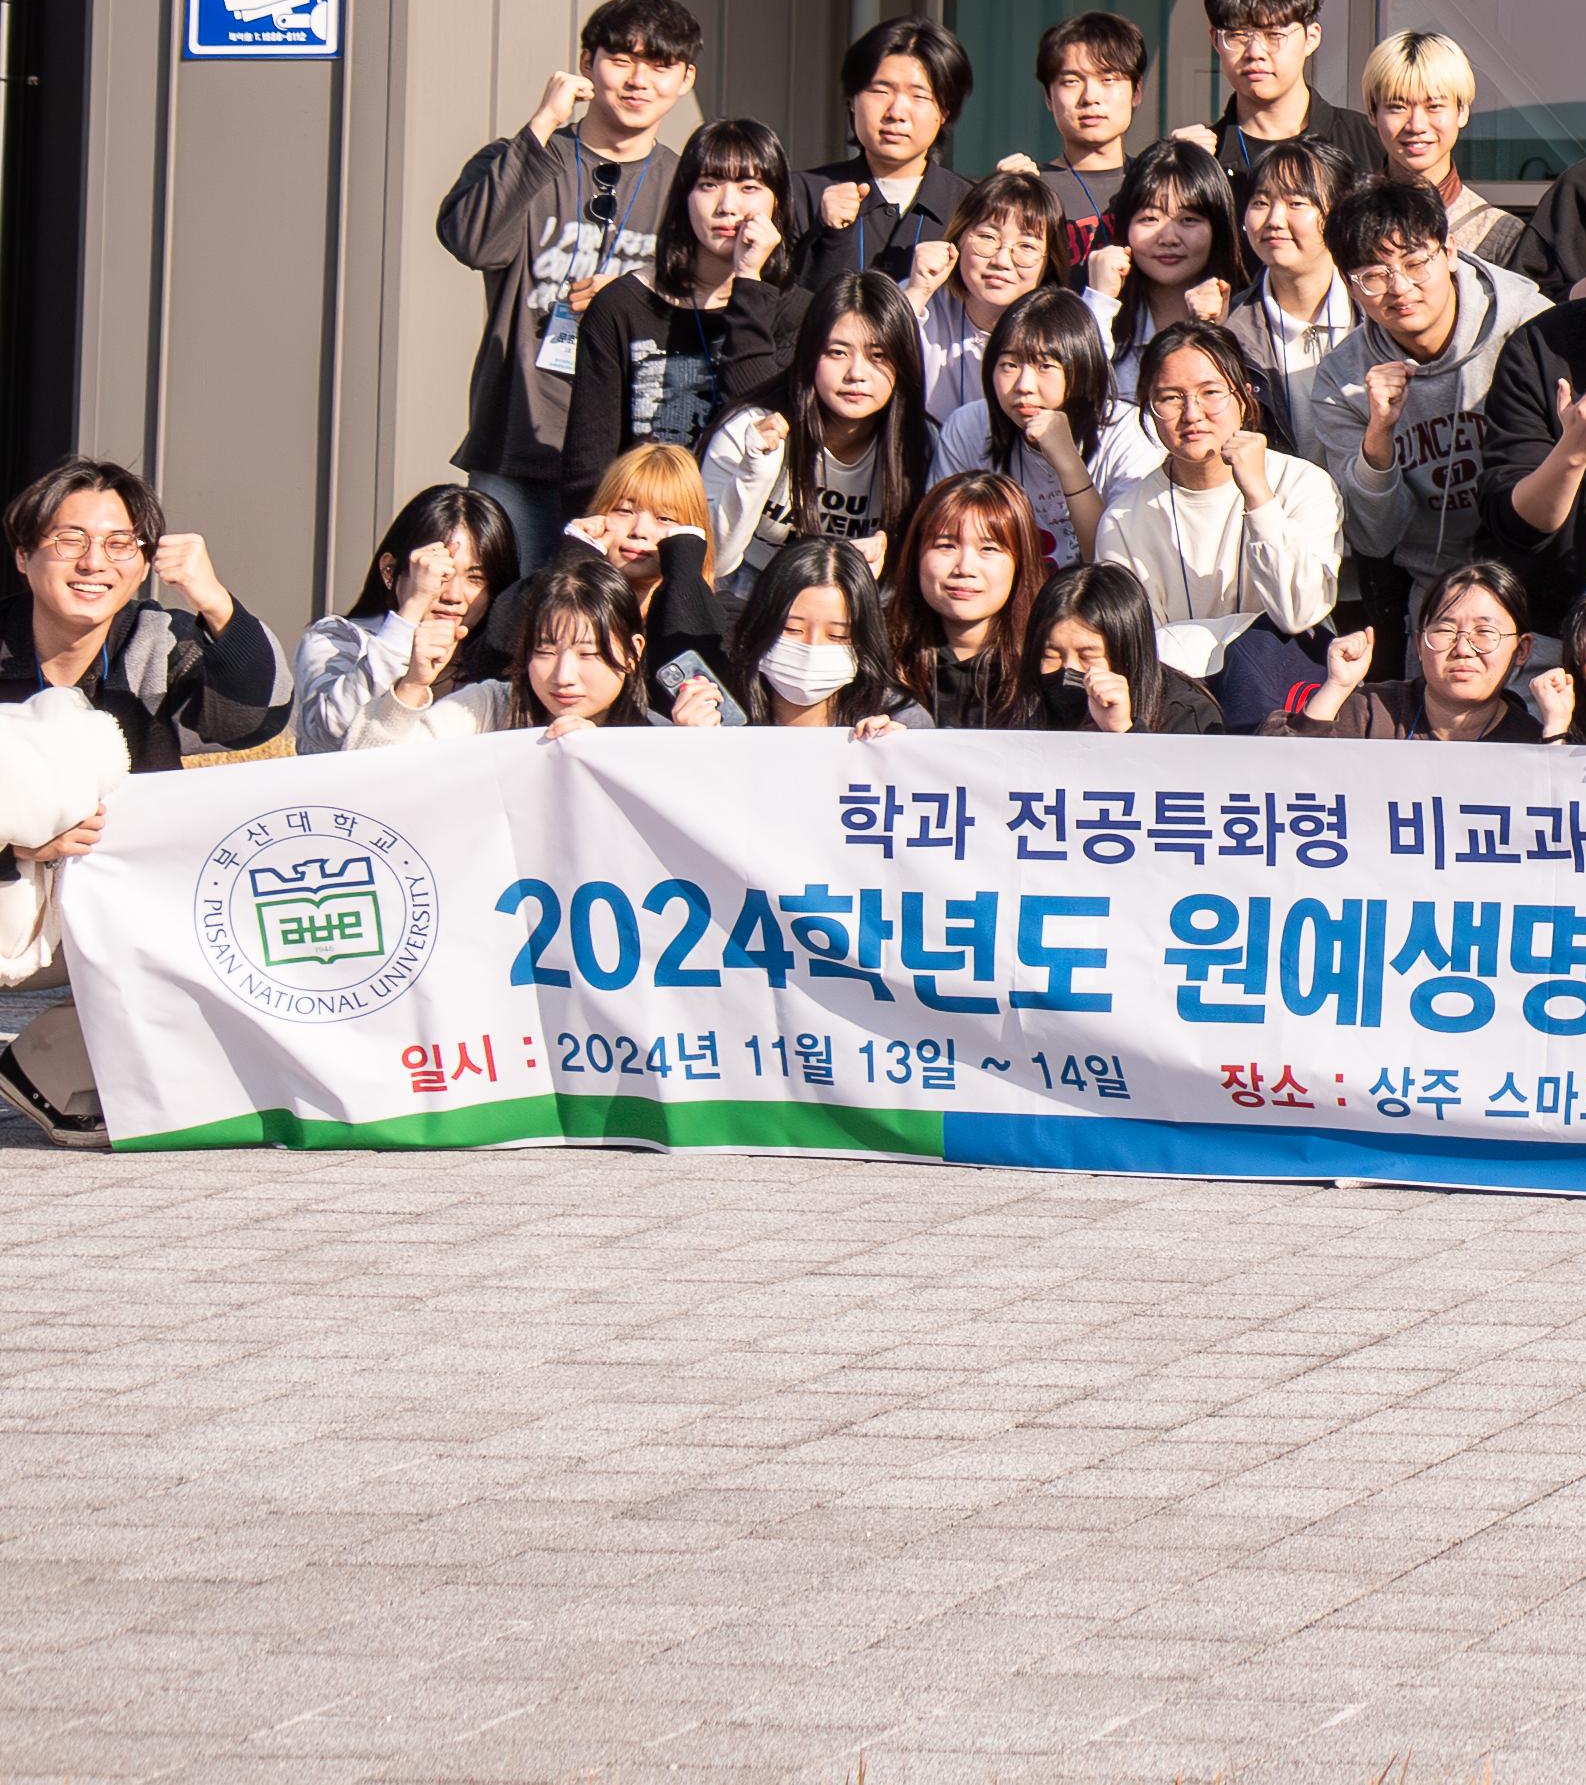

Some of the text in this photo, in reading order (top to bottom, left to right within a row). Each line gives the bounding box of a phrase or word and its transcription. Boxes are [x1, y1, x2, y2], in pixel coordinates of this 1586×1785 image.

[212, 811, 398, 869] 부산대학교
[841, 784, 975, 861] 학과
[1008, 788, 1348, 870] 전공특화형
[203, 898, 243, 975] PUSAN
[369, 874, 430, 998] UNIVERSITY
[495, 878, 1113, 1016] 2024학년도
[239, 973, 369, 1015] NATIONAL
[401, 1034, 498, 1094] 일시
[557, 1031, 721, 1082] 2024년
[744, 1033, 835, 1087] 11월
[858, 1038, 957, 1091] 13일
[1032, 1053, 1131, 1101] 14일
[1220, 1062, 1315, 1110] 장소
[1368, 1066, 1462, 1121] 상주
